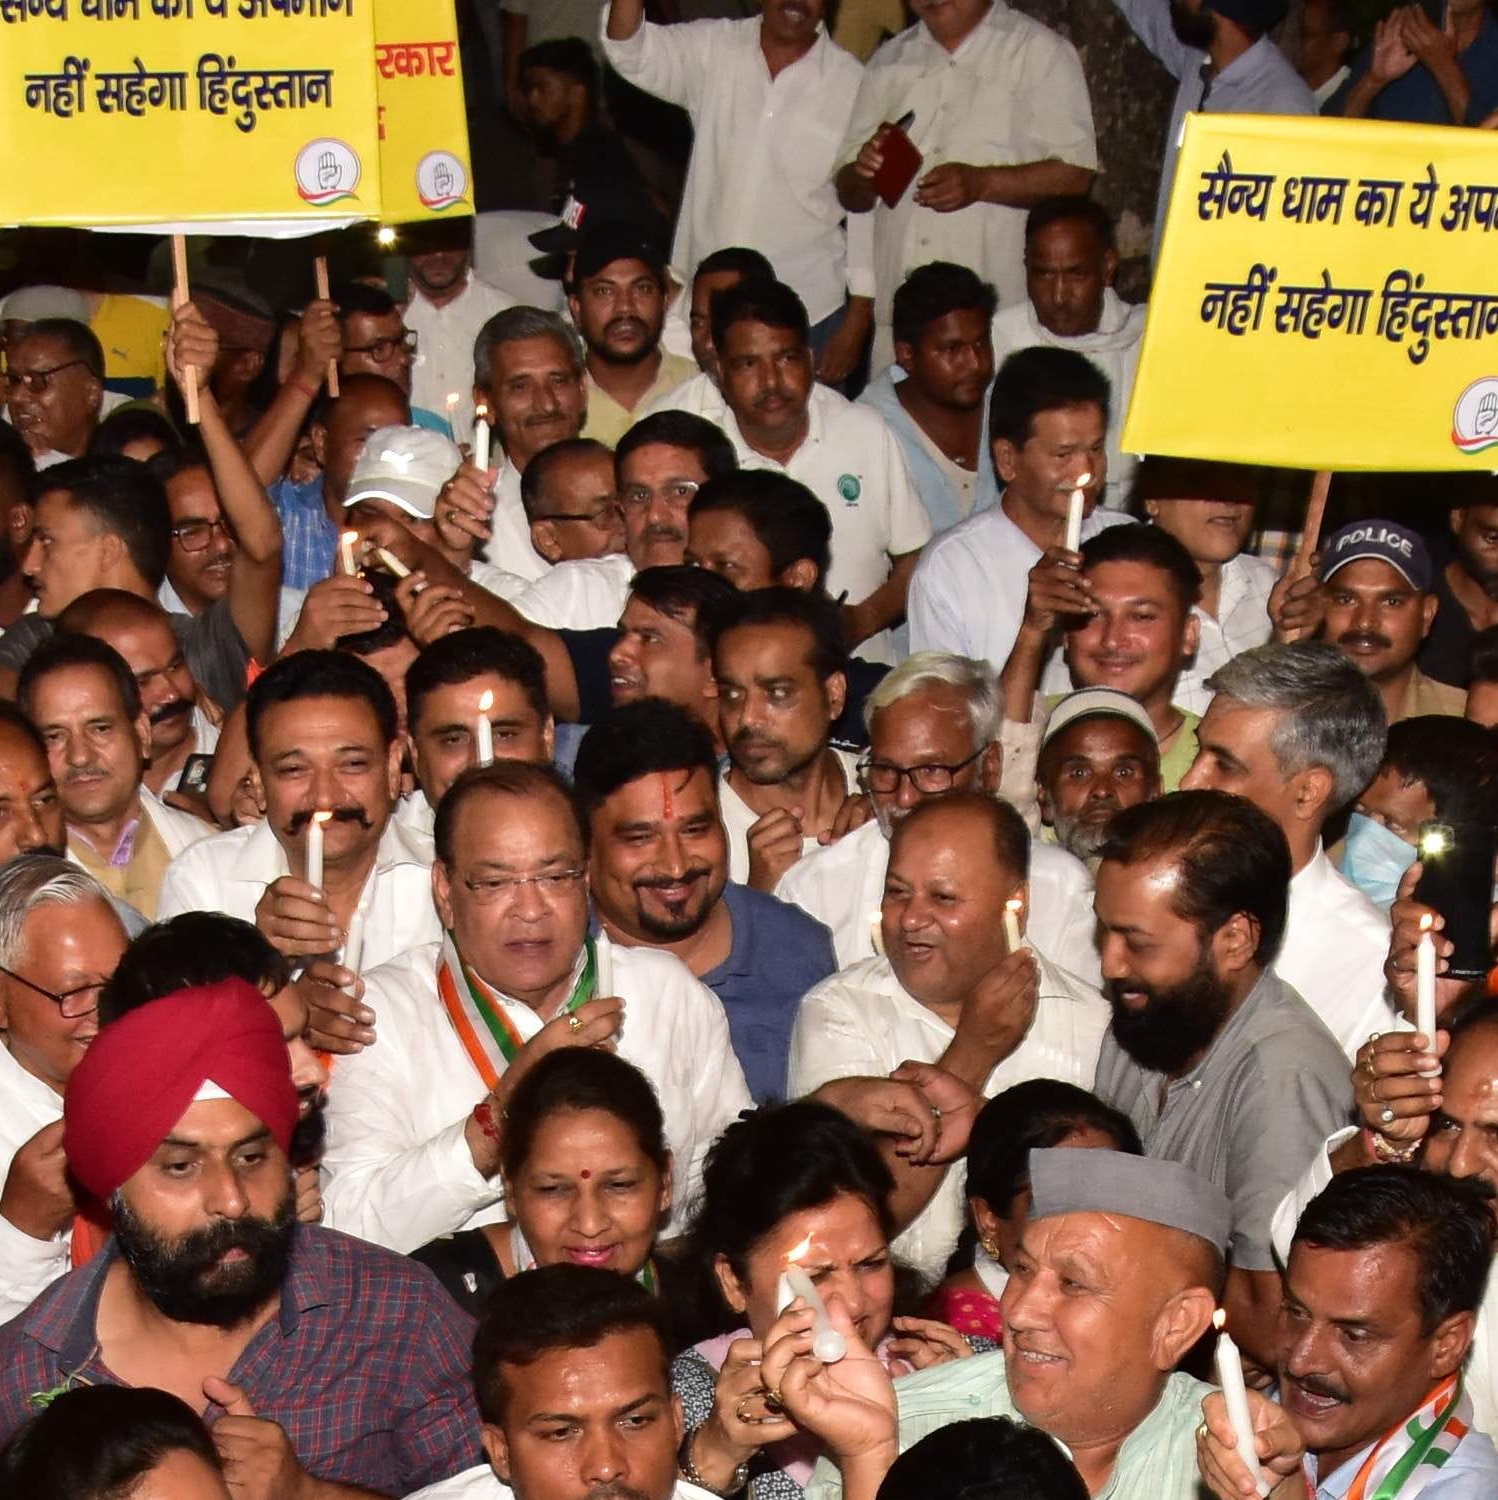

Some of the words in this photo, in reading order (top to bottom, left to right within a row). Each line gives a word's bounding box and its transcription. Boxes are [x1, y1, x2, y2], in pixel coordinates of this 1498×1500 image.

[24, 55, 91, 118] नहीं
[94, 56, 188, 117] सहेगा
[196, 53, 334, 132] हिंदुस्तान
[375, 41, 456, 79] रकार
[1198, 150, 1276, 221] सैन्य
[1282, 174, 1349, 225] धाम
[1354, 179, 1405, 227] का
[1409, 162, 1439, 229] ये
[1201, 263, 1278, 336] नहीं
[1274, 267, 1372, 339] सहेगा
[1335, 527, 1413, 558] POLICE
